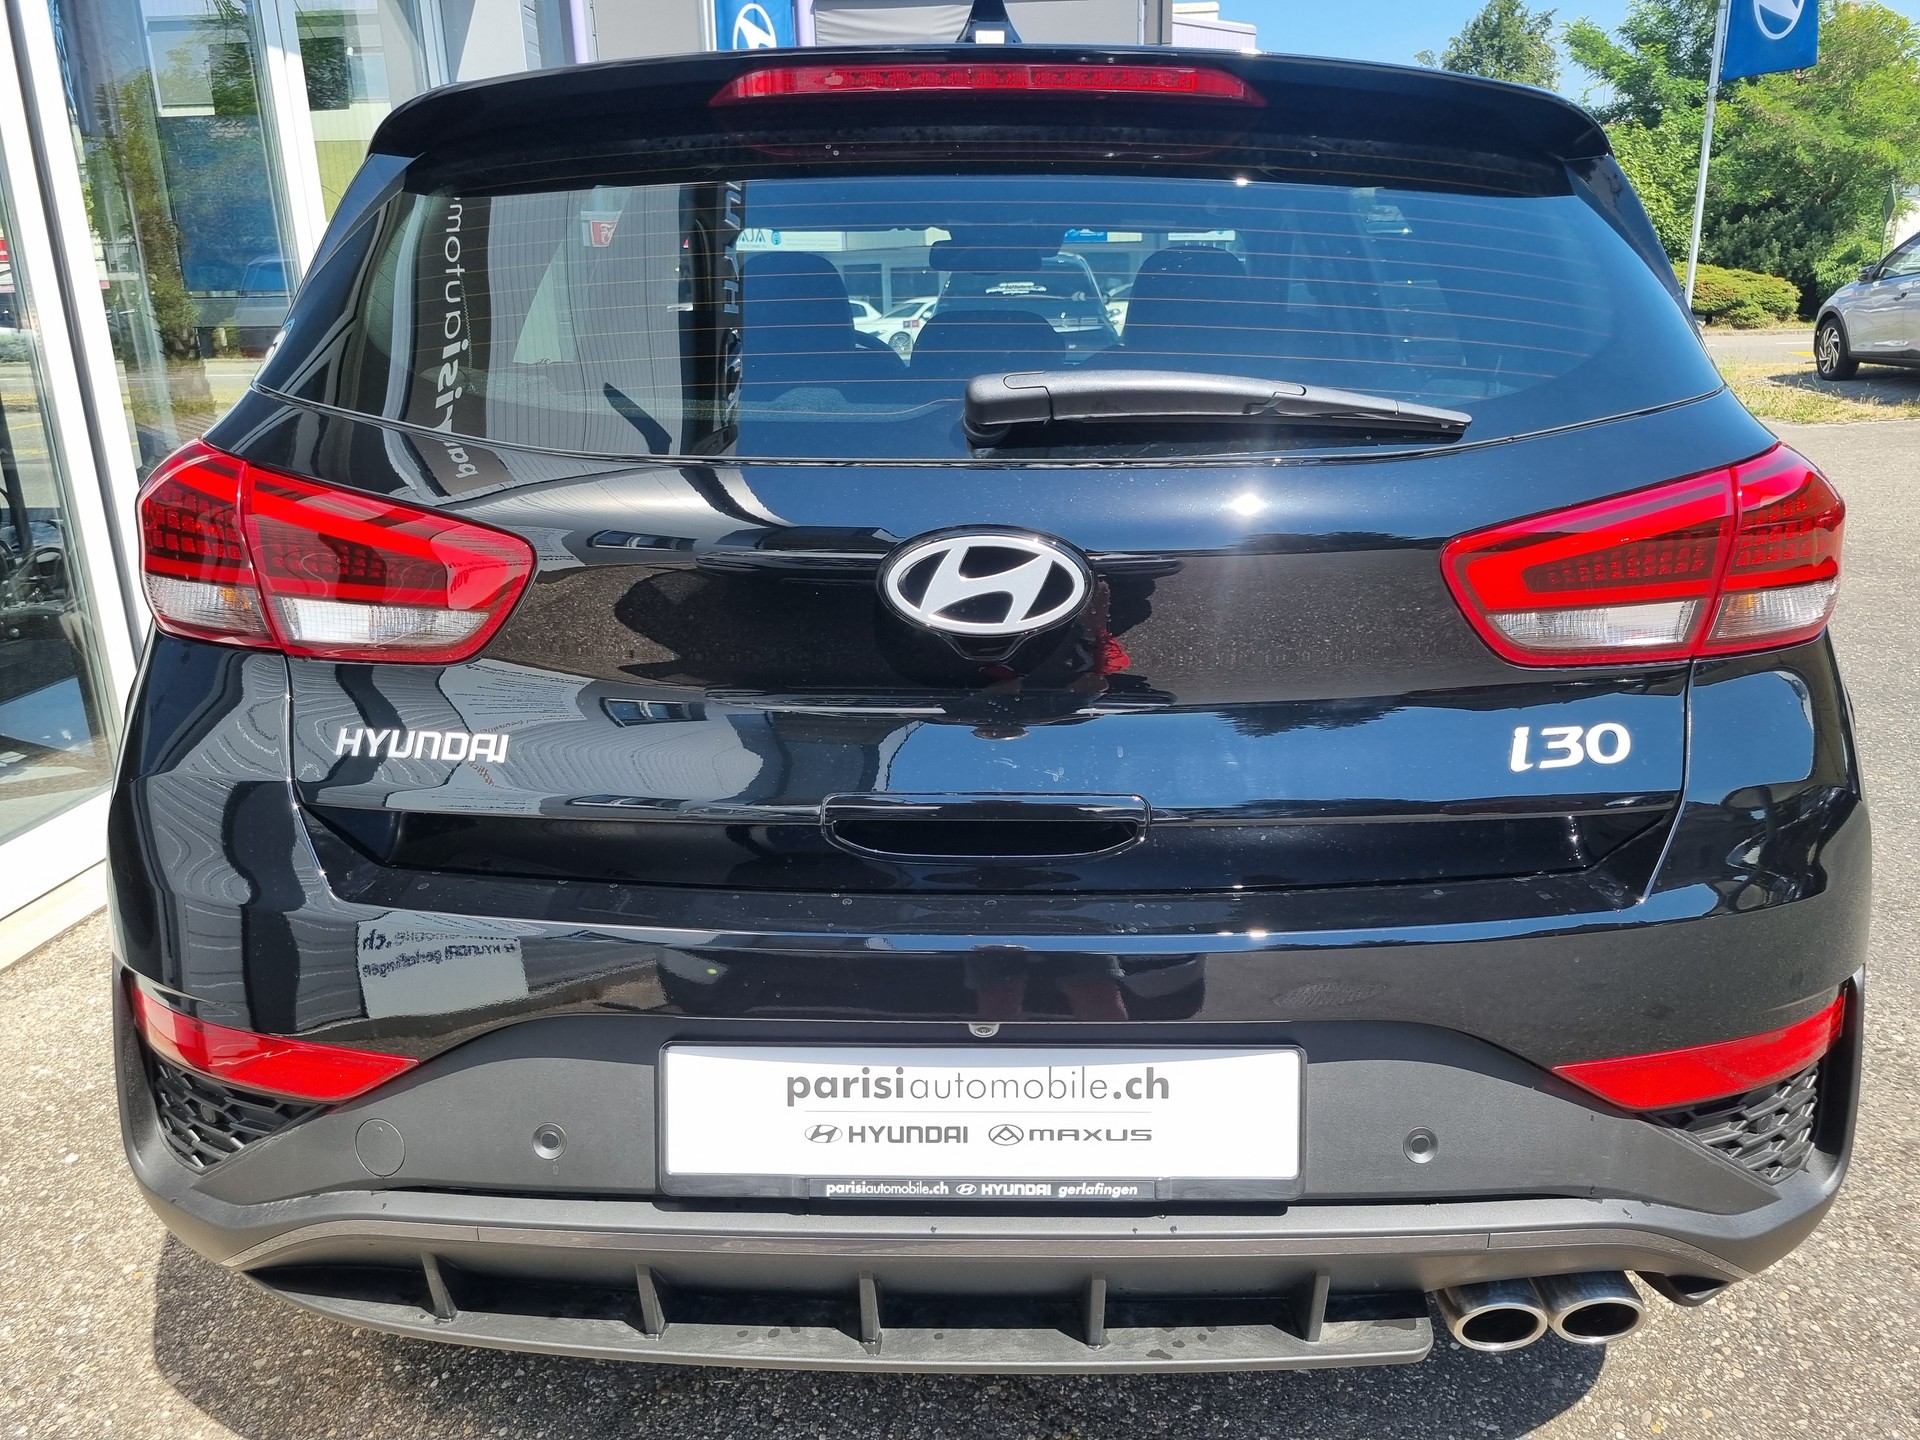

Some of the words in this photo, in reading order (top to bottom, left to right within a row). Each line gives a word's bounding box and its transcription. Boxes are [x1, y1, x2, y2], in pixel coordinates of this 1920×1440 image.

[335, 726, 510, 764] HYUNDAI
[1510, 722, 1631, 773] i30
[786, 1066, 1170, 1107] parisiautomobile.ch
[848, 1125, 969, 1144] HYUNDAI
[1029, 1128, 1153, 1142] MAXUS
[826, 1180, 949, 1197] parisiautomobile.ch
[981, 1183, 1052, 1196] HYUNDAI
[1058, 1183, 1138, 1197] gerlafingen
